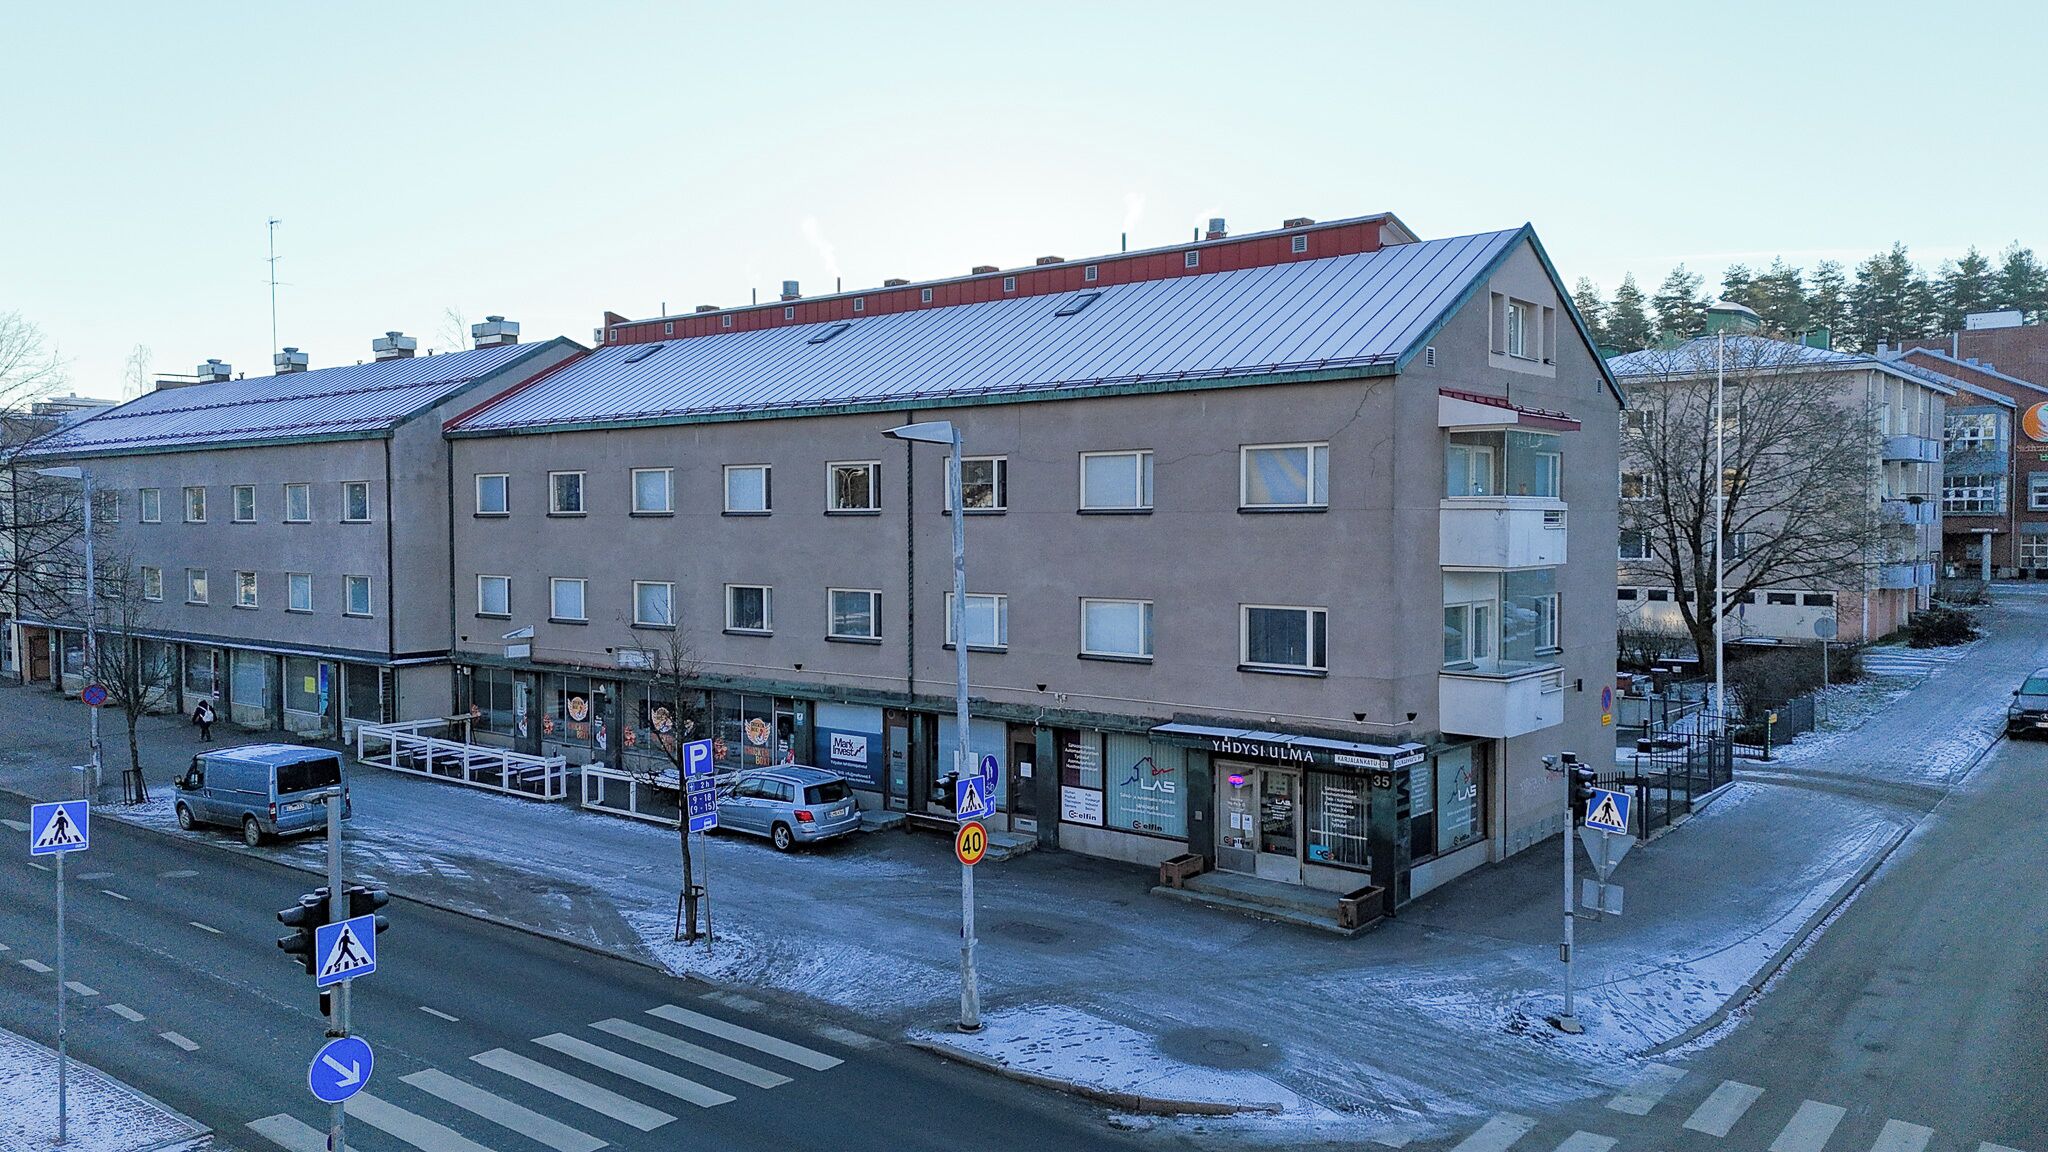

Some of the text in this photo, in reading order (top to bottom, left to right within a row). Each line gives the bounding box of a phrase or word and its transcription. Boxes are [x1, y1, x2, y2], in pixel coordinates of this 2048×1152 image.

[834, 738, 853, 748] Mark
[833, 745, 855, 756] Invest
[690, 744, 708, 774] P
[1337, 755, 1378, 766] KARJALANKATU
[1141, 778, 1175, 793] LAS
[1373, 775, 1390, 787] 35
[1458, 784, 1476, 801] LAS
[963, 832, 981, 854] 40
